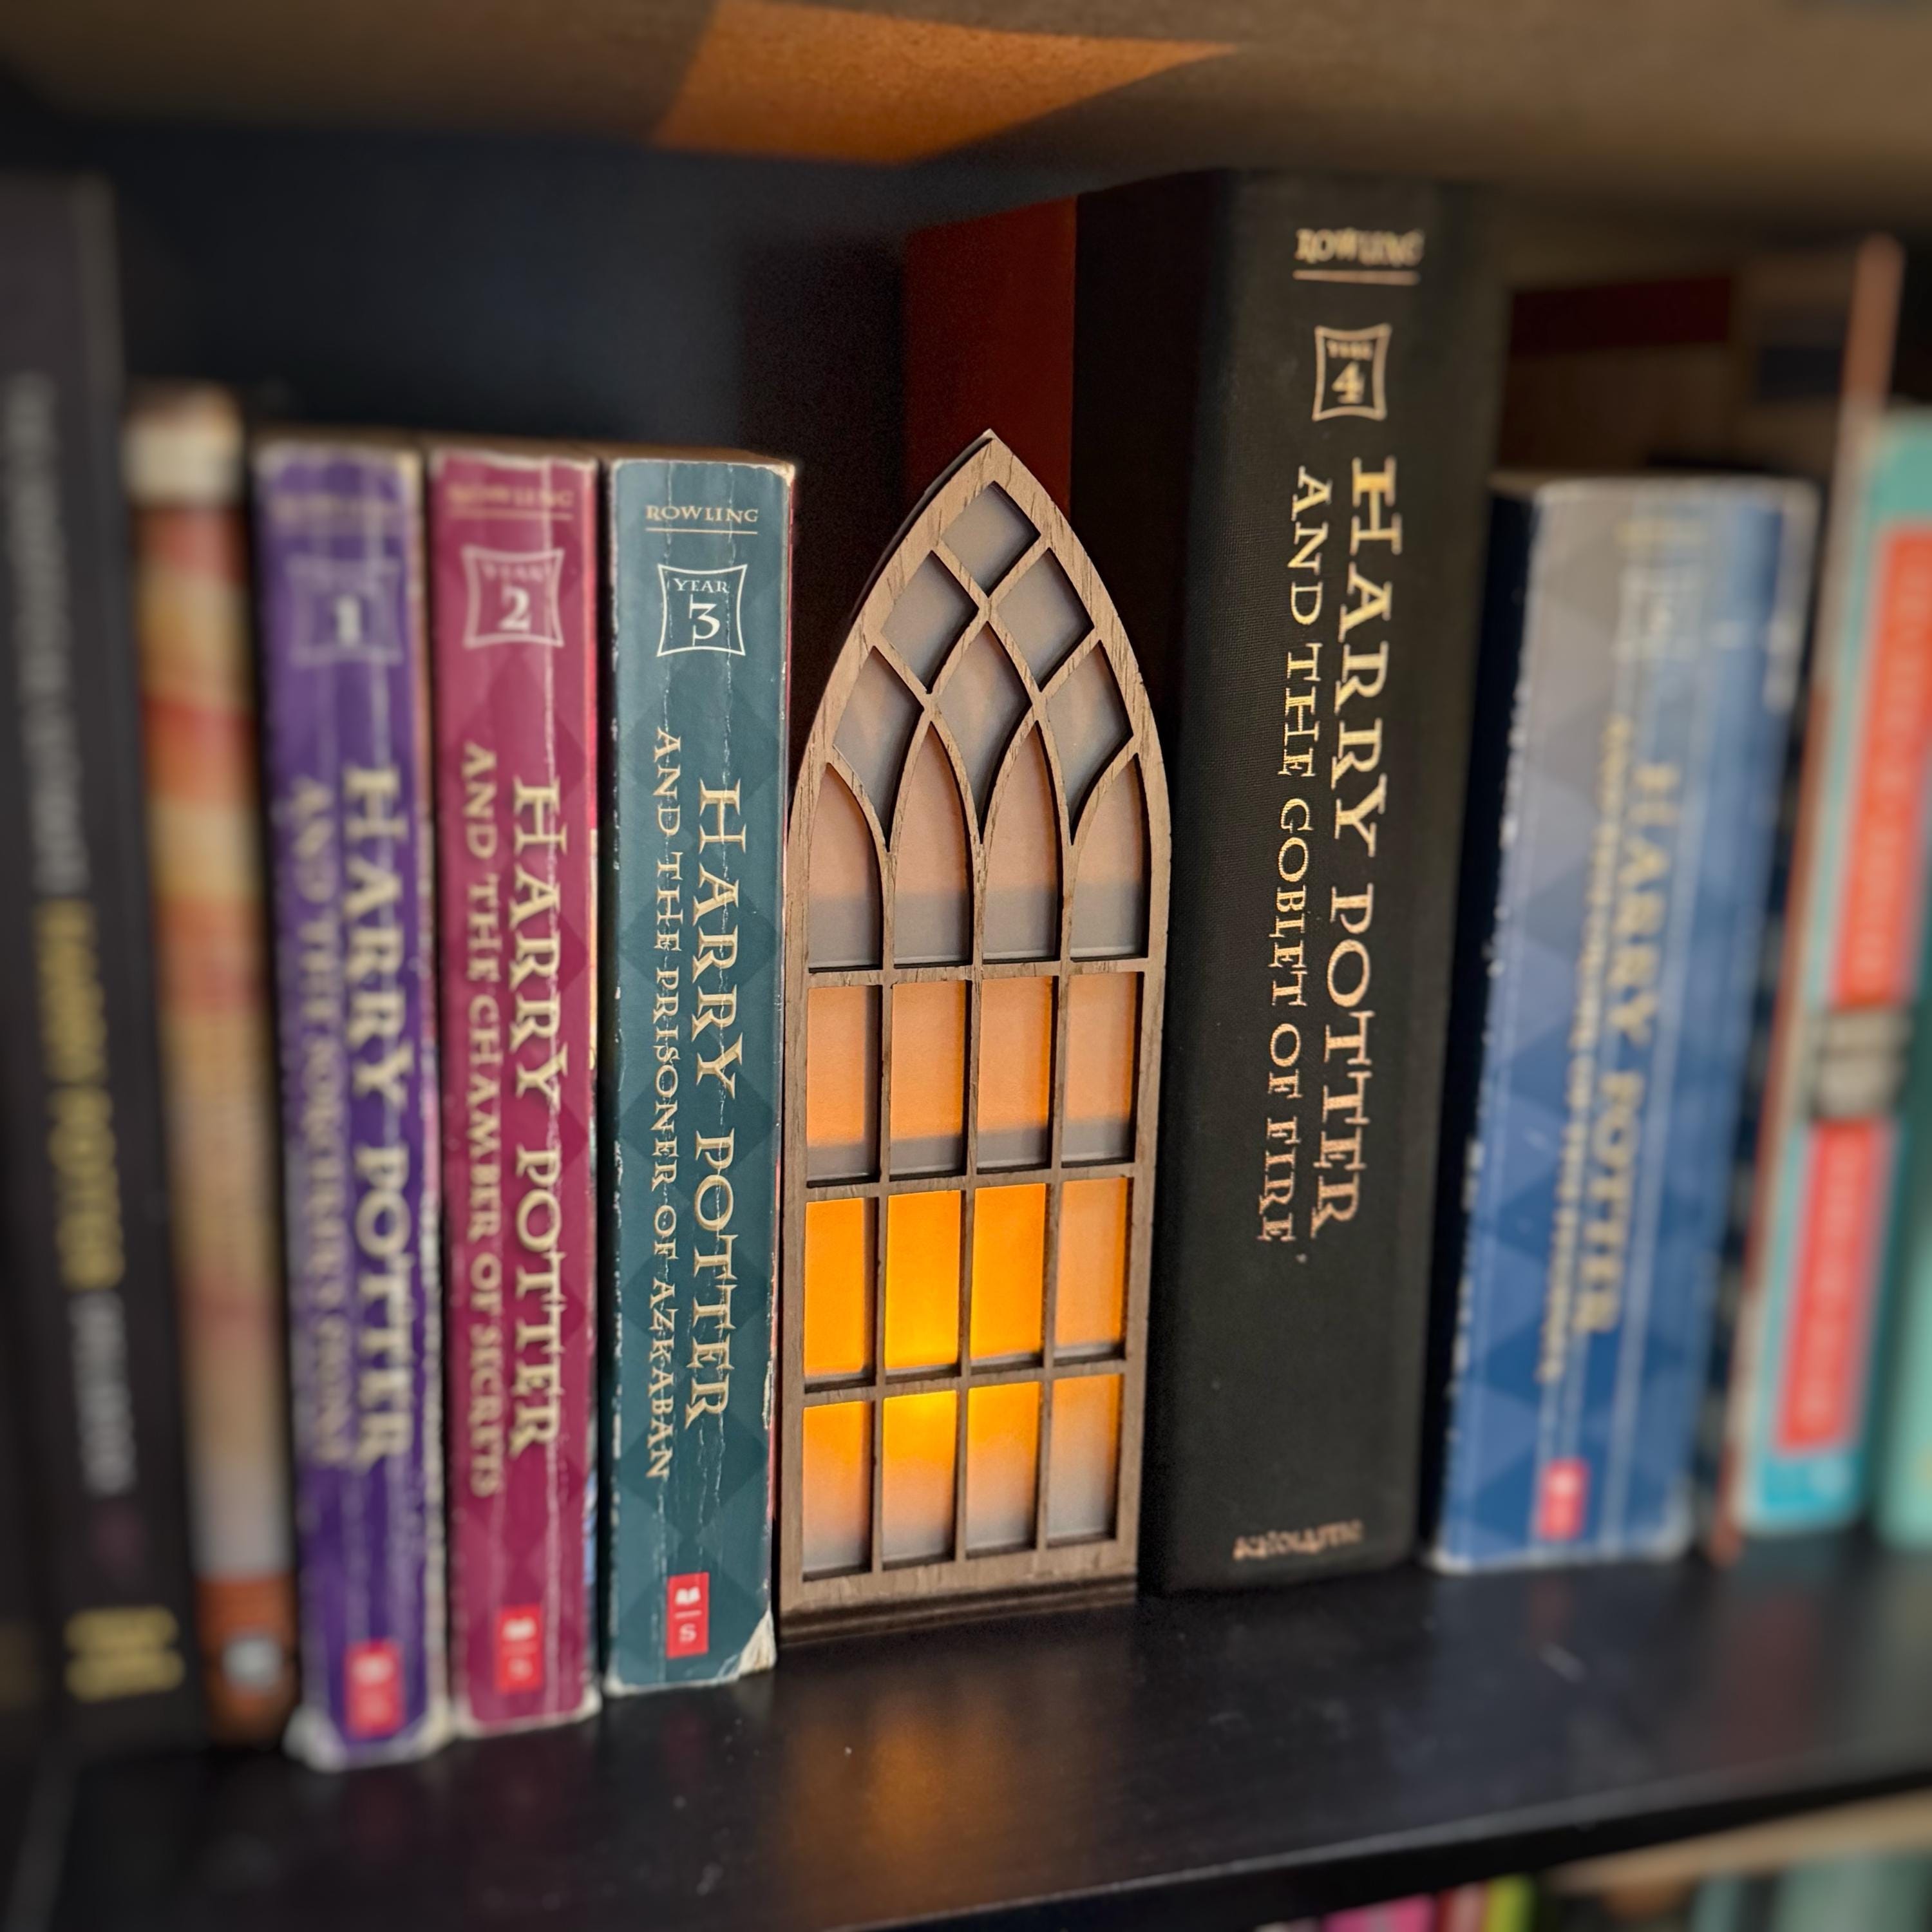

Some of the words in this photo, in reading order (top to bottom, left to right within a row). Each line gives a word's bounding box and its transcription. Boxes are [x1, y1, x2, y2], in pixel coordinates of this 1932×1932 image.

[1331, 361, 1366, 404] 4
[646, 506, 759, 524] ROWLING
[1289, 465, 1332, 627] AND
[334, 591, 363, 646] 1
[498, 585, 532, 633] 2
[674, 578, 730, 594] YEAR
[688, 594, 721, 647] 3
[1278, 642, 1322, 777] THE
[1331, 455, 1403, 858] HARRY
[460, 740, 498, 860] AND
[653, 726, 681, 835] AND
[341, 765, 413, 1111] HARRY
[466, 873, 504, 983] THE
[507, 775, 568, 1113] HARRY
[652, 851, 683, 952] THE
[691, 778, 746, 1099] HARRY
[1268, 798, 1311, 1007] GOBLET
[464, 992, 505, 1245] CHAMBER
[650, 965, 681, 1193] PRISONER
[1267, 1023, 1303, 1099] OF
[1311, 883, 1377, 1239] POTTER
[653, 1204, 680, 1260] OF
[1257, 1115, 1302, 1242] FIRE
[354, 1145, 415, 1473] POTTER
[468, 1252, 505, 1318] OF
[509, 1142, 568, 1460] POTTER
[685, 1128, 739, 1430] POTTER
[646, 1276, 679, 1479] AZKABAN
